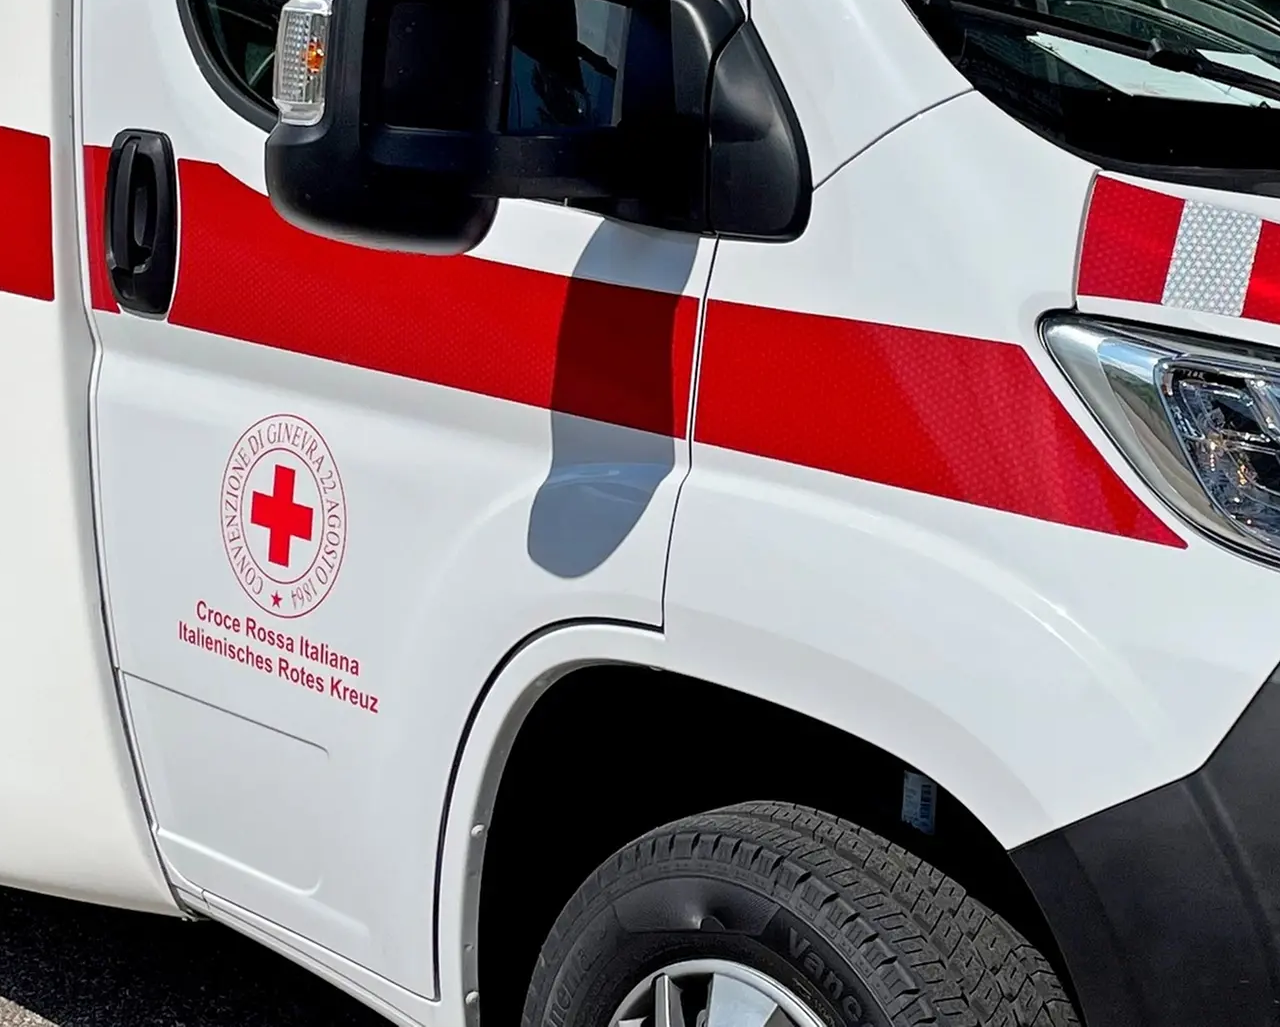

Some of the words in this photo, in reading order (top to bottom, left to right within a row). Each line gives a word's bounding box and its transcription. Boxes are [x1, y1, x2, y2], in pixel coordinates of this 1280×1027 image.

[248, 429, 265, 456] DI
[267, 422, 325, 473] GINEVRA
[320, 470, 337, 494] 22
[224, 447, 264, 596] CONVENZIONE
[315, 499, 342, 586] AGOSTO
[290, 577, 318, 610] 1864
[178, 620, 273, 673] Italienisches
[278, 658, 325, 693] Rotes
[330, 676, 379, 714] Kreuz
[196, 600, 241, 633] Croce
[246, 617, 294, 654] Rossa
[299, 635, 360, 677] Italiana
